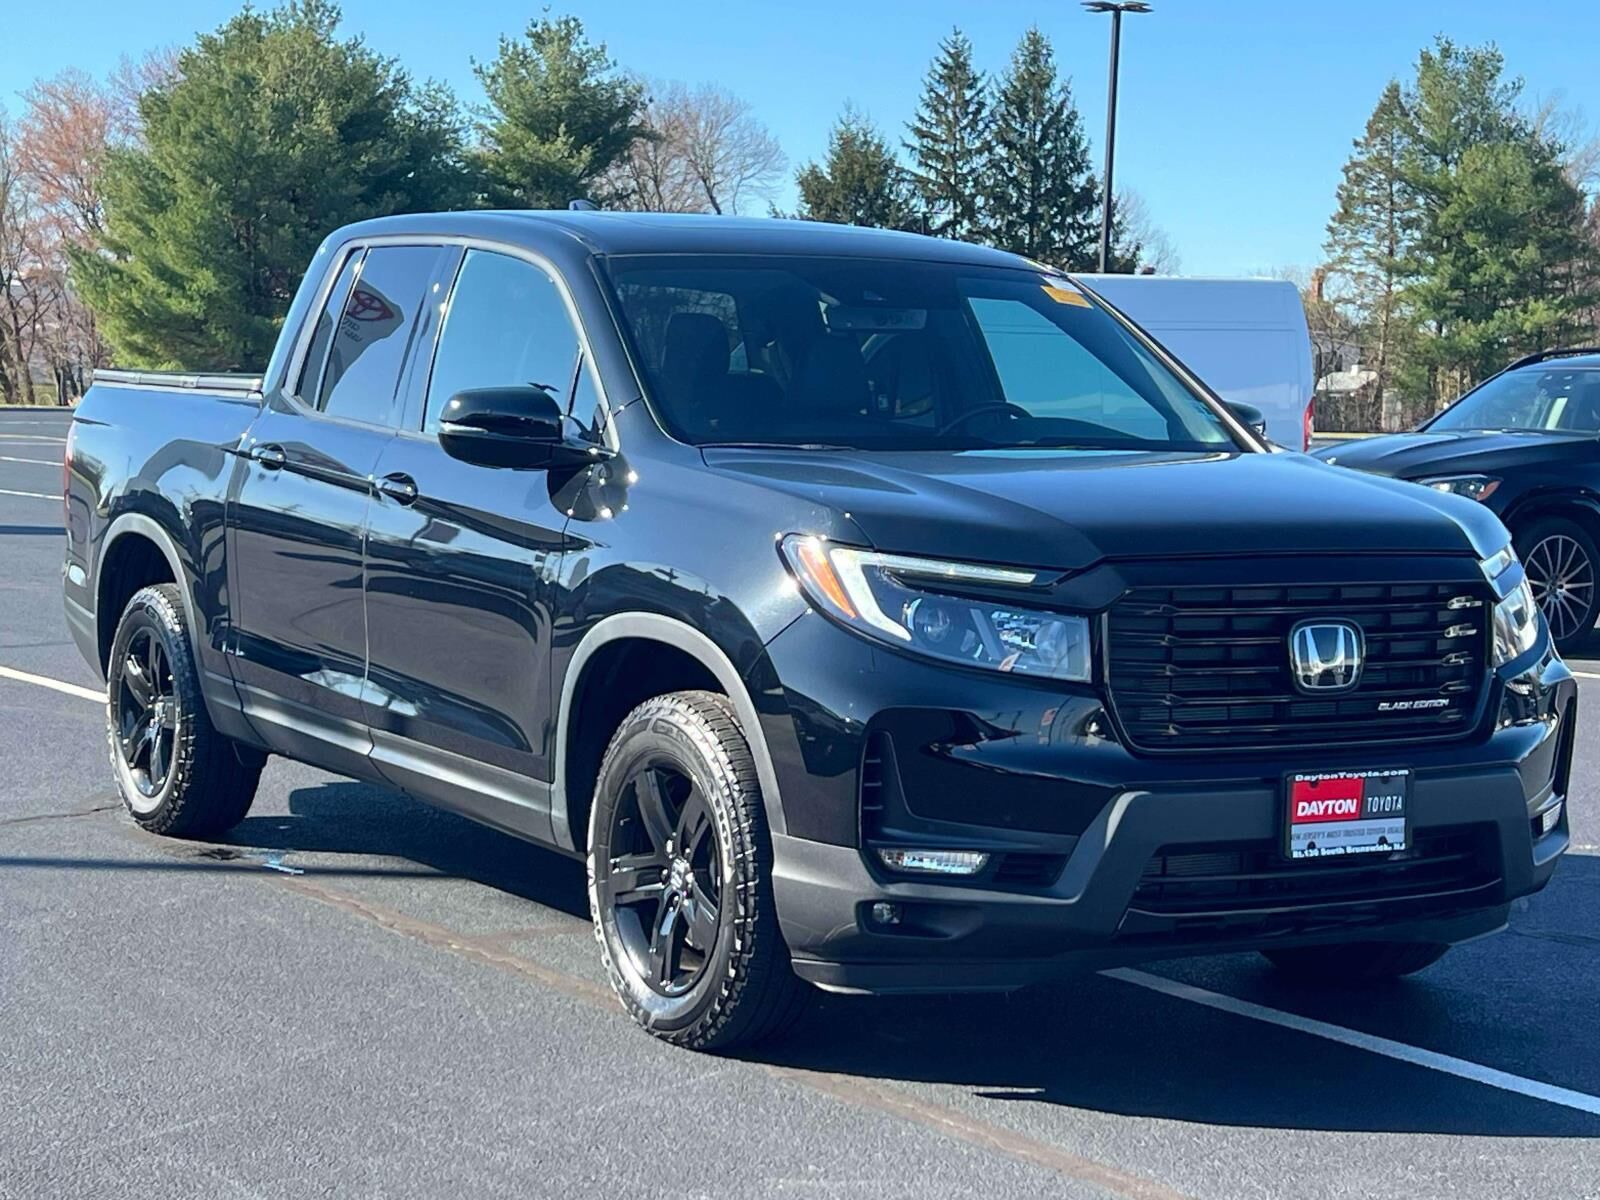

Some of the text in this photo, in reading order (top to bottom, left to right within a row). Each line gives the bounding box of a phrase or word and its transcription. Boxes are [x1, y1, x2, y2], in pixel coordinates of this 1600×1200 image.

[1377, 698, 1450, 711] BLACK EDITION
[1295, 769, 1409, 782] DaytonToyota.com
[1296, 796, 1403, 817] DAYTON TOYOTA
